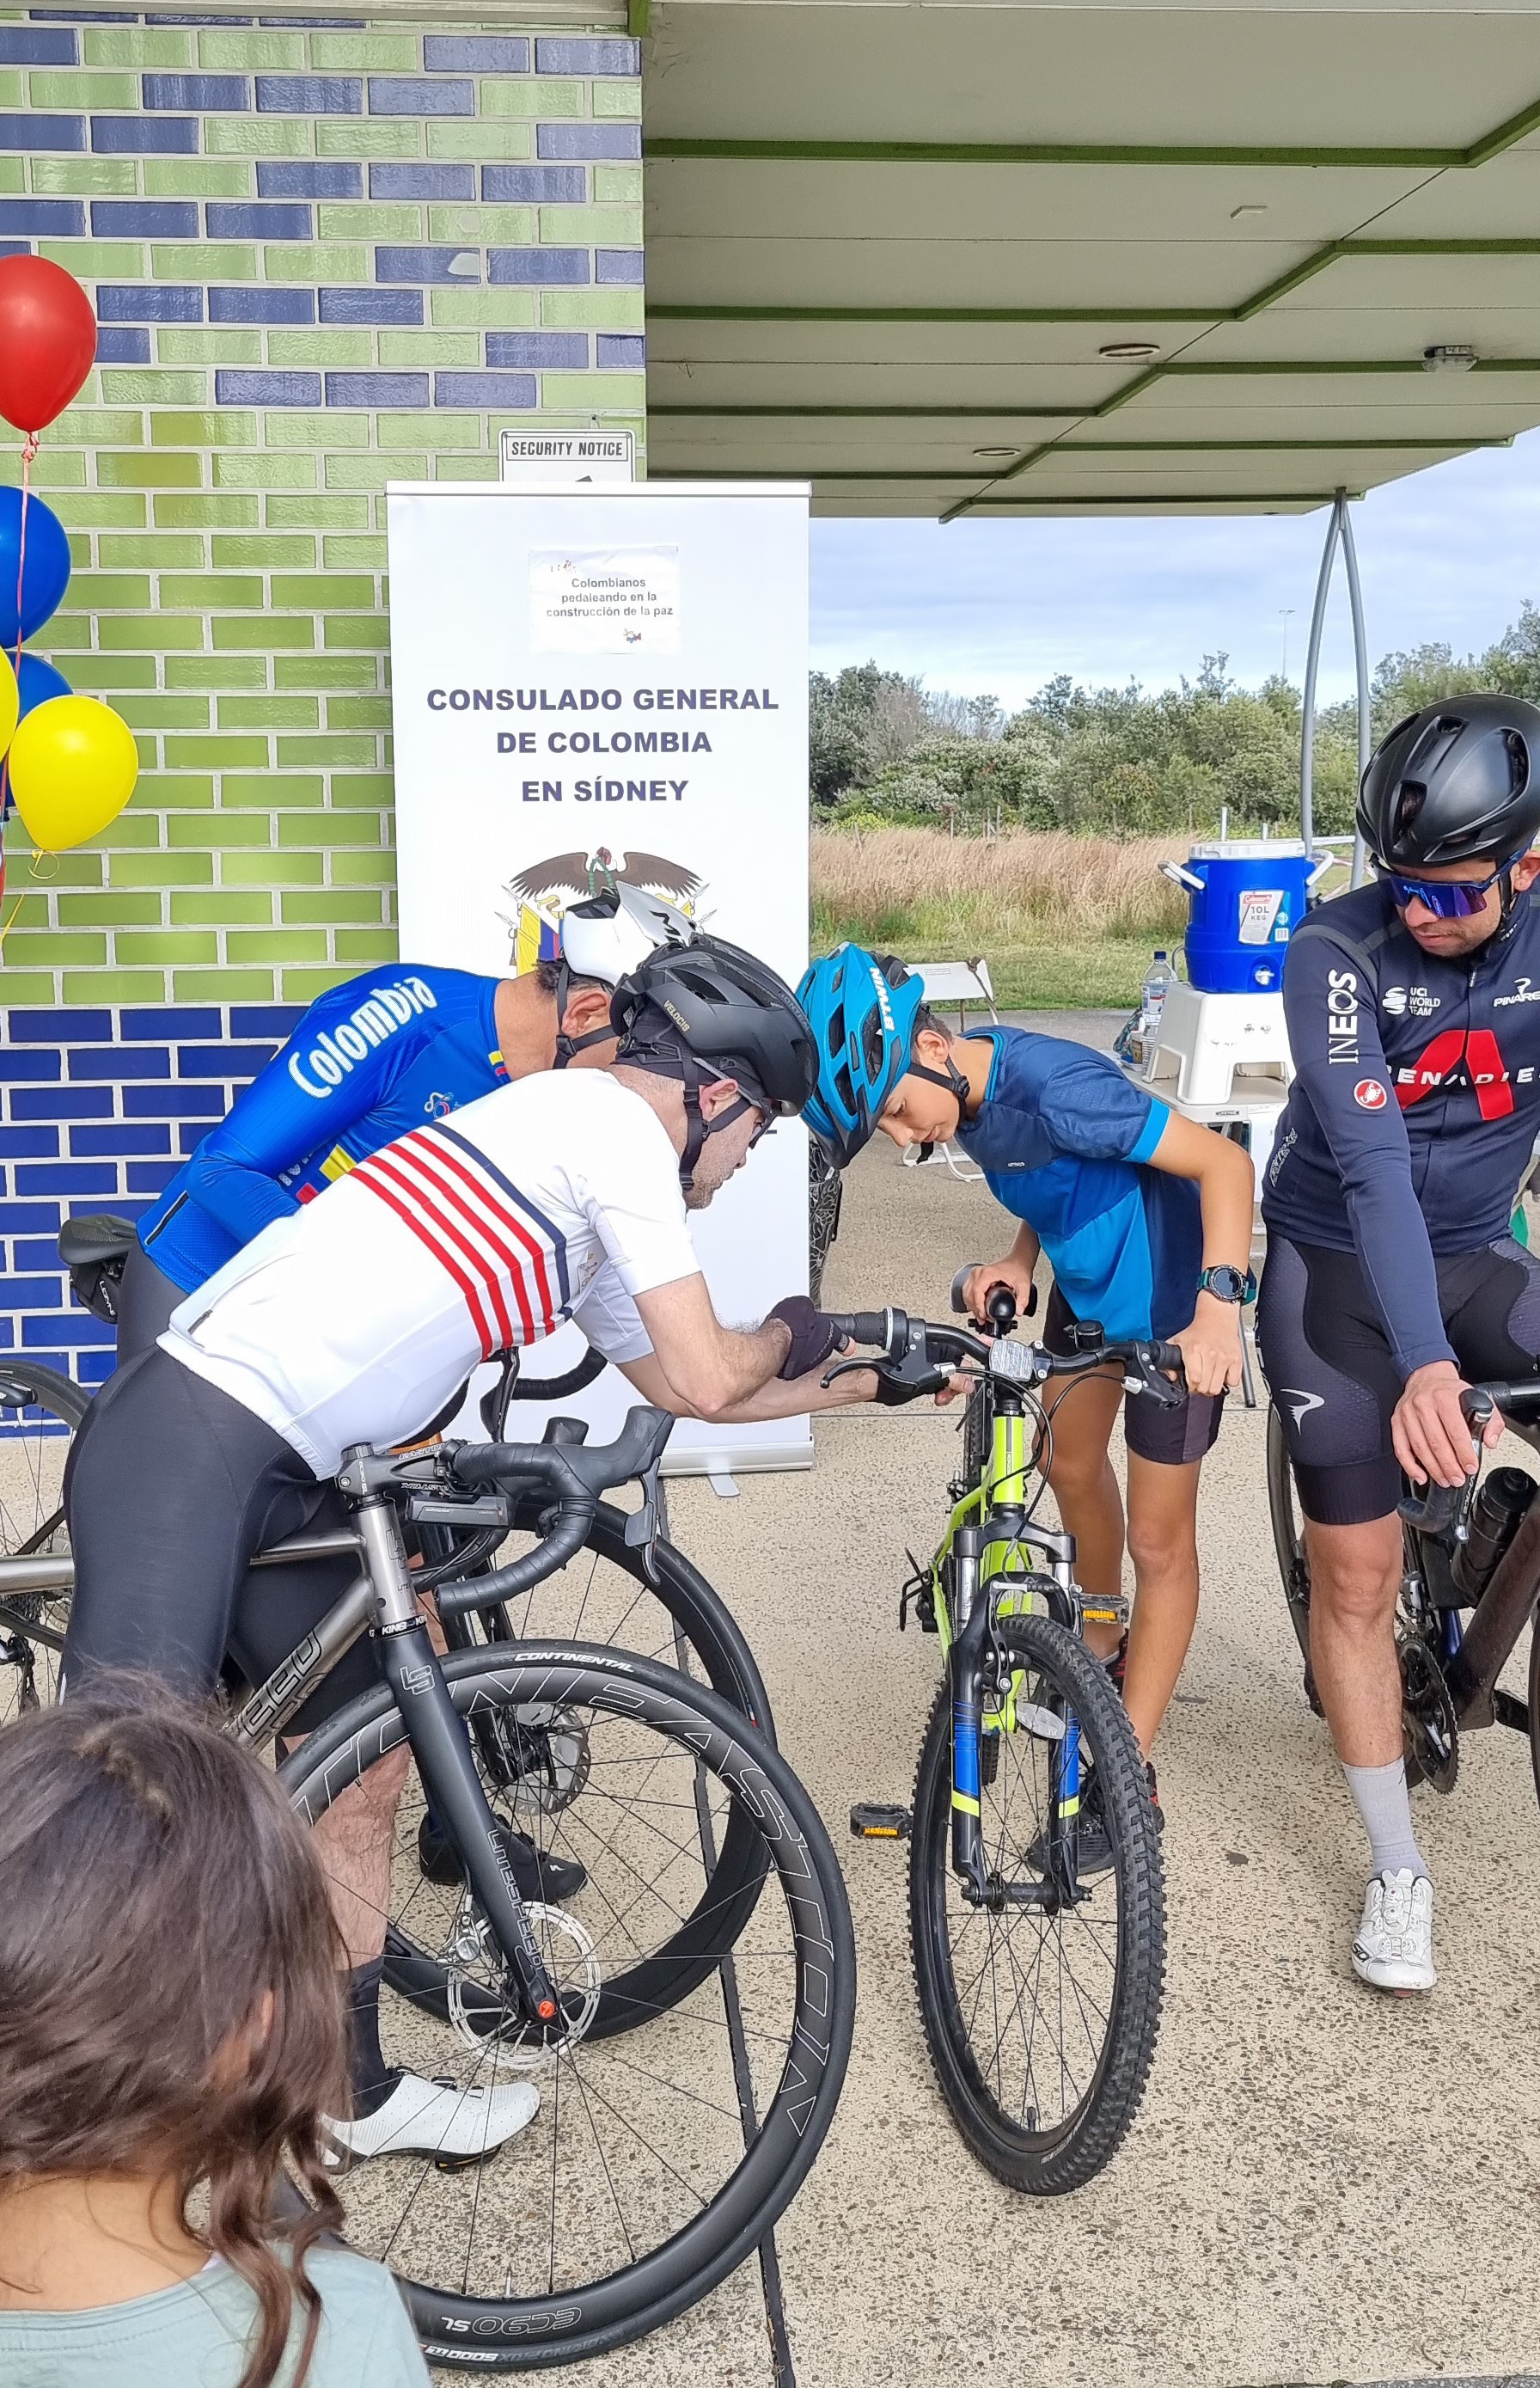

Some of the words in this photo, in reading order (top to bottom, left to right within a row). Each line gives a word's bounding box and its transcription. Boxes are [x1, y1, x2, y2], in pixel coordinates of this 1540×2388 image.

[511, 441, 572, 456] SECURITY
[578, 442, 623, 456] NOTICE
[571, 577, 646, 588] Colombianos
[561, 591, 627, 604] pedaleando
[630, 592, 645, 602] en
[647, 591, 657, 602] la
[546, 606, 620, 617] construcción
[623, 606, 637, 616] de
[640, 605, 651, 615] la
[653, 607, 674, 618] paz
[427, 689, 622, 711] CONSULADO
[632, 689, 779, 710] GENERAL
[497, 732, 537, 754] DE
[547, 732, 712, 754] COLOMBIA
[522, 781, 563, 802] EN
[573, 775, 689, 802] SÍDNEY
[1250, 905, 1270, 914] 10L
[1409, 986, 1428, 997] UCI
[1409, 997, 1442, 1007] WORLD
[663, 999, 691, 1032] VELOCIS
[1327, 969, 1360, 1065] INEOS
[1408, 1005, 1433, 1016] TEAM
[288, 976, 438, 1099] Colombia
[382, 1621, 408, 1636] KING
[514, 1651, 635, 1674] CONTINENTAL
[486, 1828, 545, 1972] LITESPEED
[440, 2316, 472, 2333] SL
[472, 2306, 583, 2336] EC90
[448, 2349, 499, 2362] 5000
